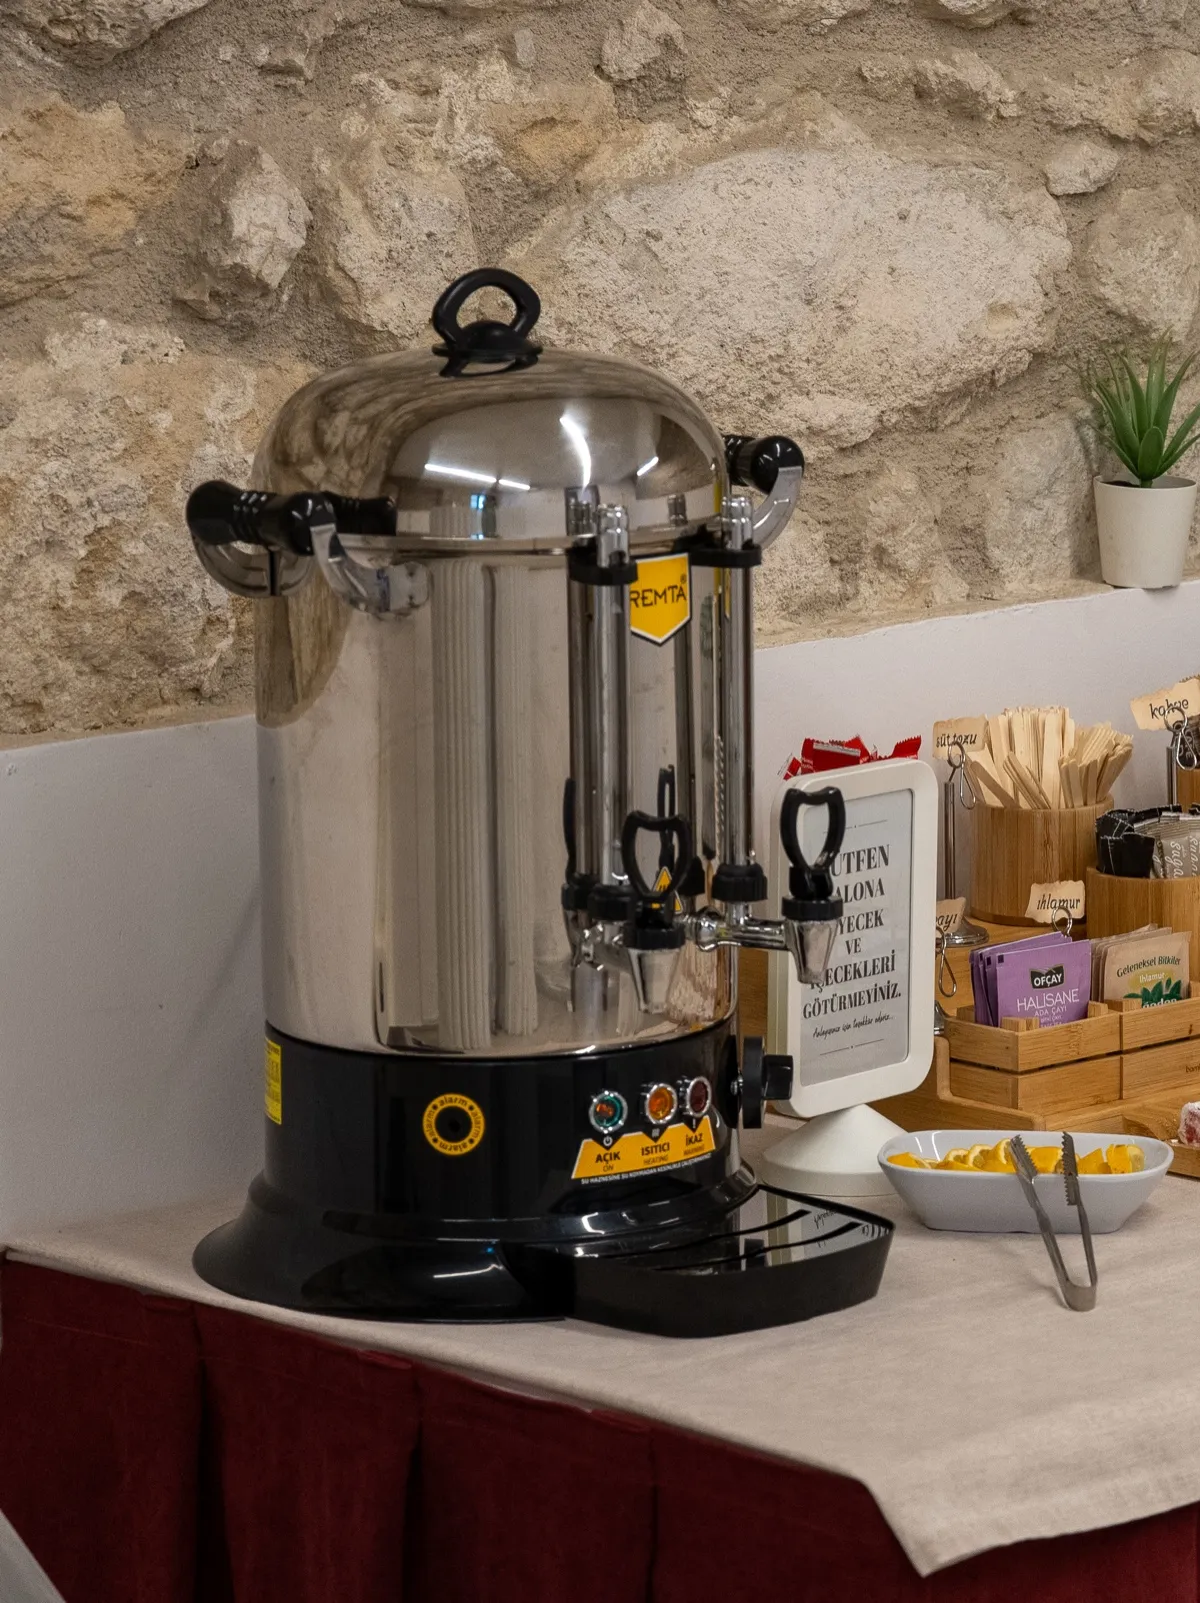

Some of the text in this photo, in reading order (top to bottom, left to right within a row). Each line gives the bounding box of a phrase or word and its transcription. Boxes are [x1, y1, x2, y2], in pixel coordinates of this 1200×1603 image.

[936, 733, 977, 748] süt tozu
[835, 877, 885, 903] ALONA
[839, 908, 884, 935] YECEK
[936, 913, 958, 932] ayı
[845, 937, 862, 955] VE
[1033, 973, 1062, 987] OFÇAY
[803, 980, 902, 1020] GÖTÜRMEYİNİZ.
[439, 1095, 468, 1107] alarm
[595, 1151, 620, 1165] AÇIK
